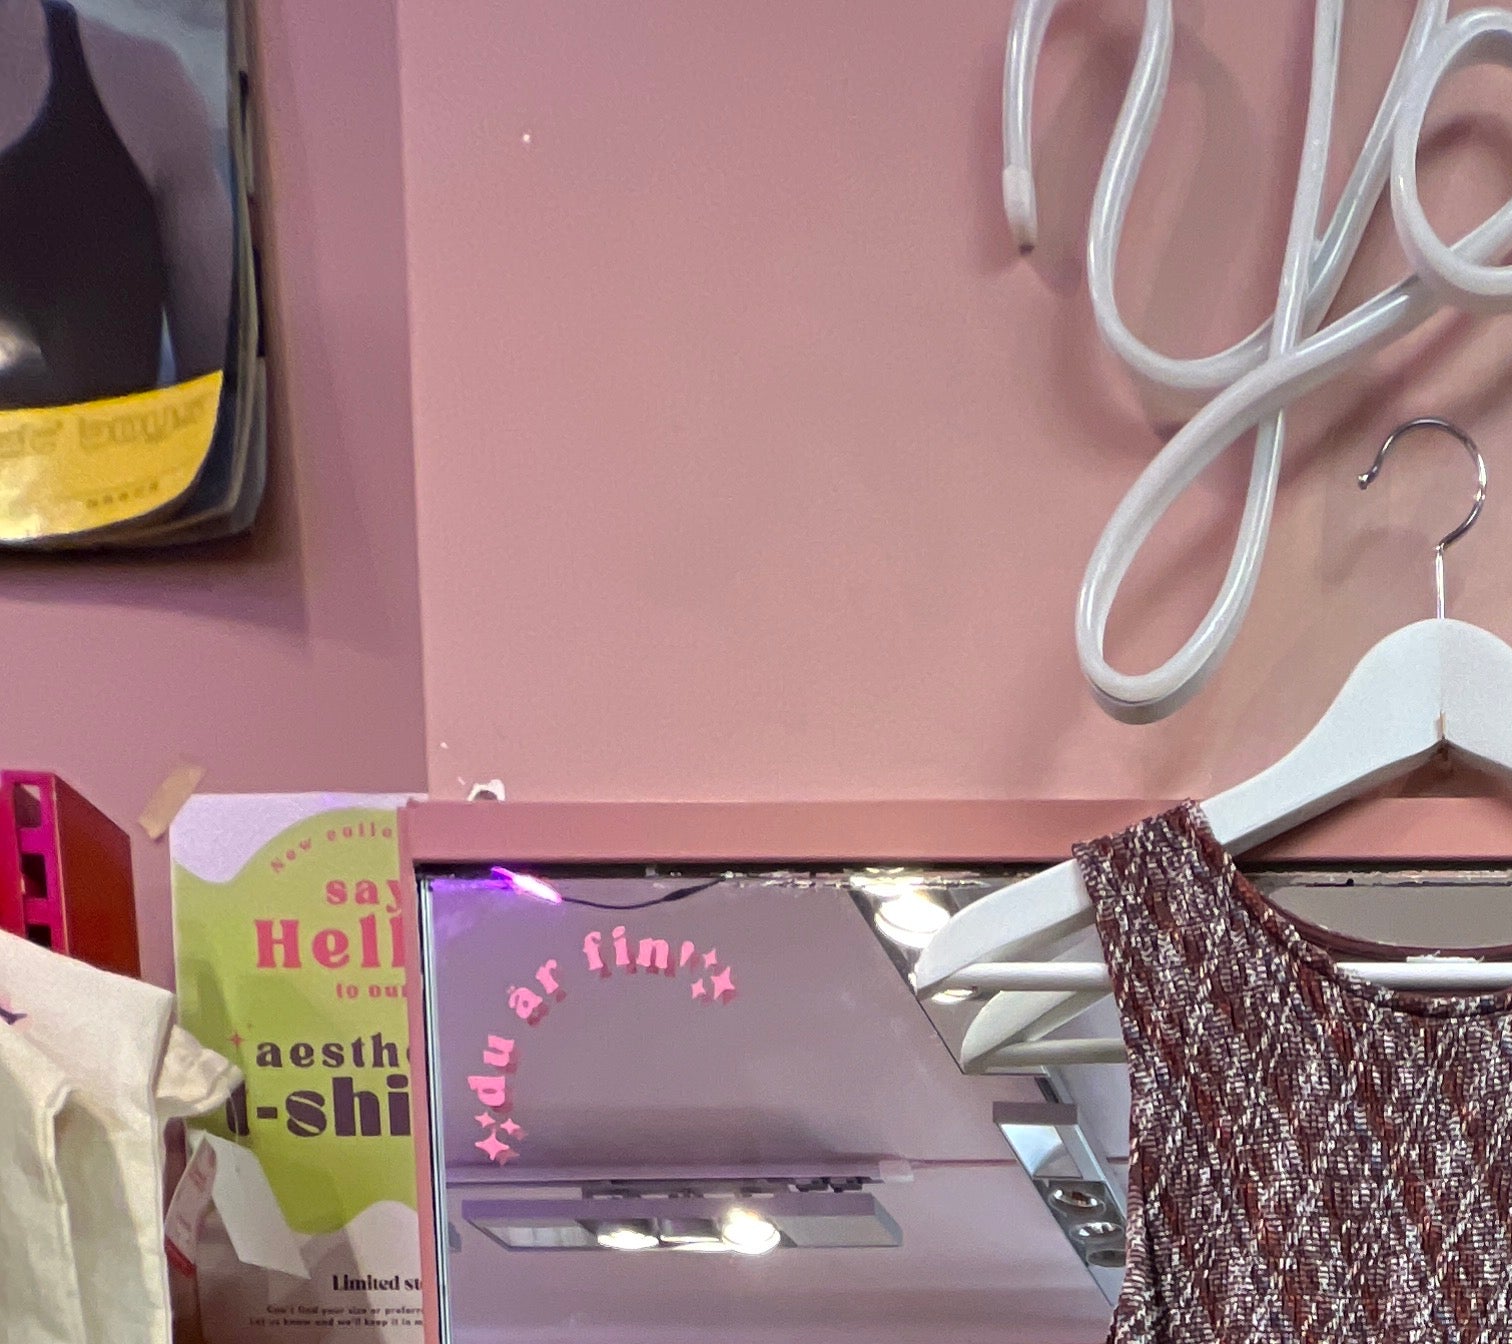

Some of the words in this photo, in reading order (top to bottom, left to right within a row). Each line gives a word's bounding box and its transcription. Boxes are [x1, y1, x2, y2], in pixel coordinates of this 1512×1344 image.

[324, 879, 403, 914] say
[254, 913, 405, 970] Hell
[335, 981, 360, 1000] to
[467, 1034, 515, 1107] du
[508, 958, 560, 1020] är
[254, 1030, 410, 1071] aesth
[332, 1274, 400, 1292] Limited
[404, 1274, 423, 1291] st
[384, 1304, 424, 1317] preferr
